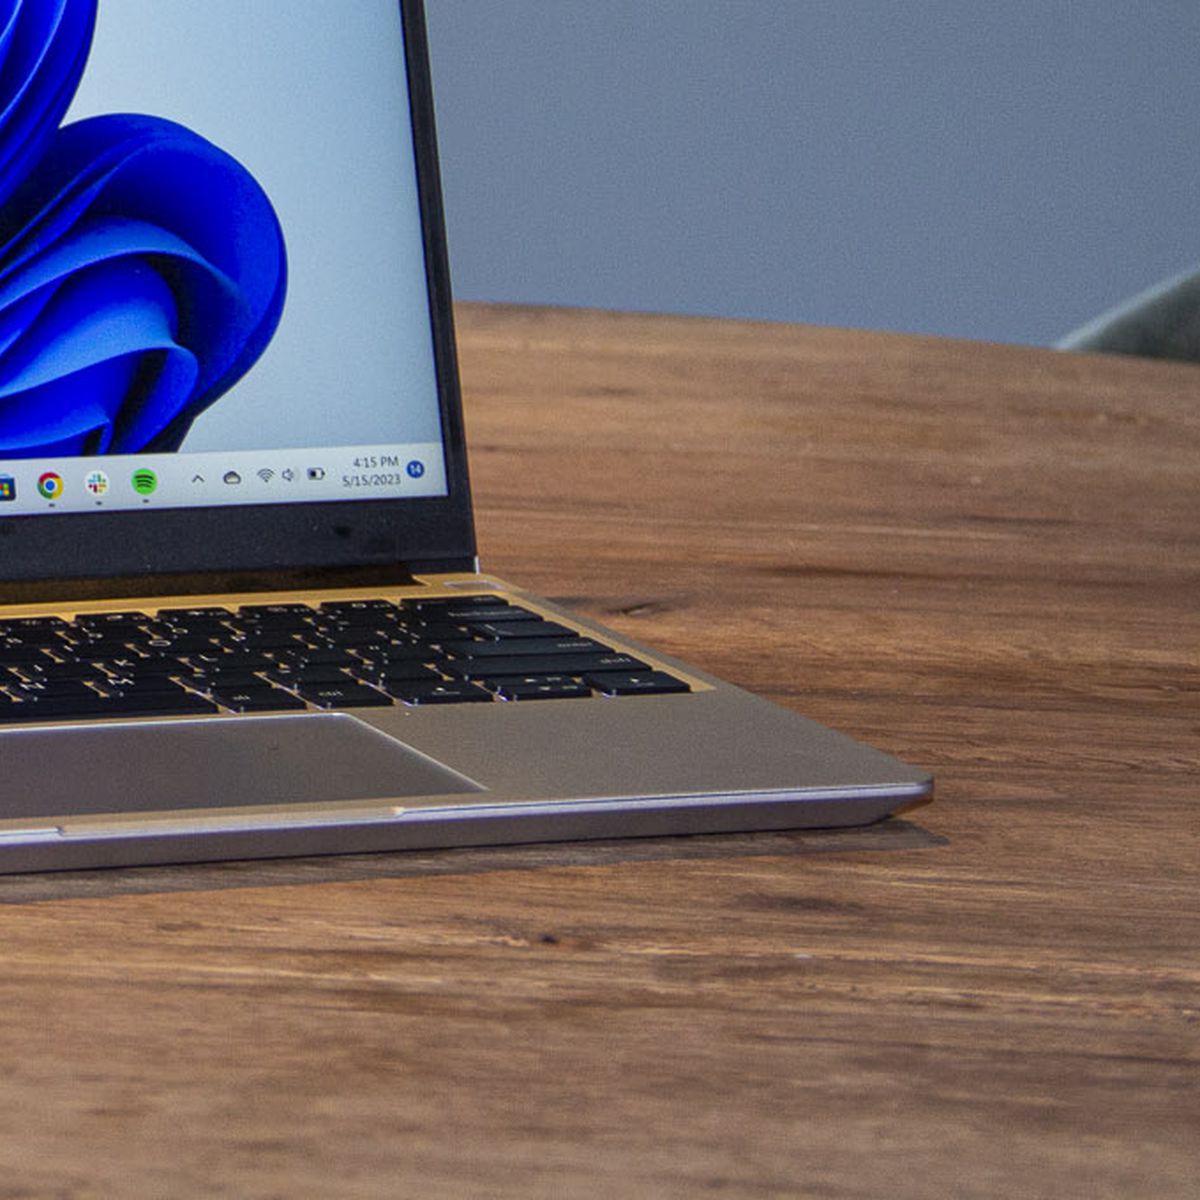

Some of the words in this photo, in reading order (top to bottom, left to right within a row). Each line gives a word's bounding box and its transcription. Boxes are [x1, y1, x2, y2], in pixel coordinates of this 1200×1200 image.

[353, 457, 377, 468] 4:15
[380, 456, 399, 467] PM
[342, 474, 401, 487] 5/15/2023
